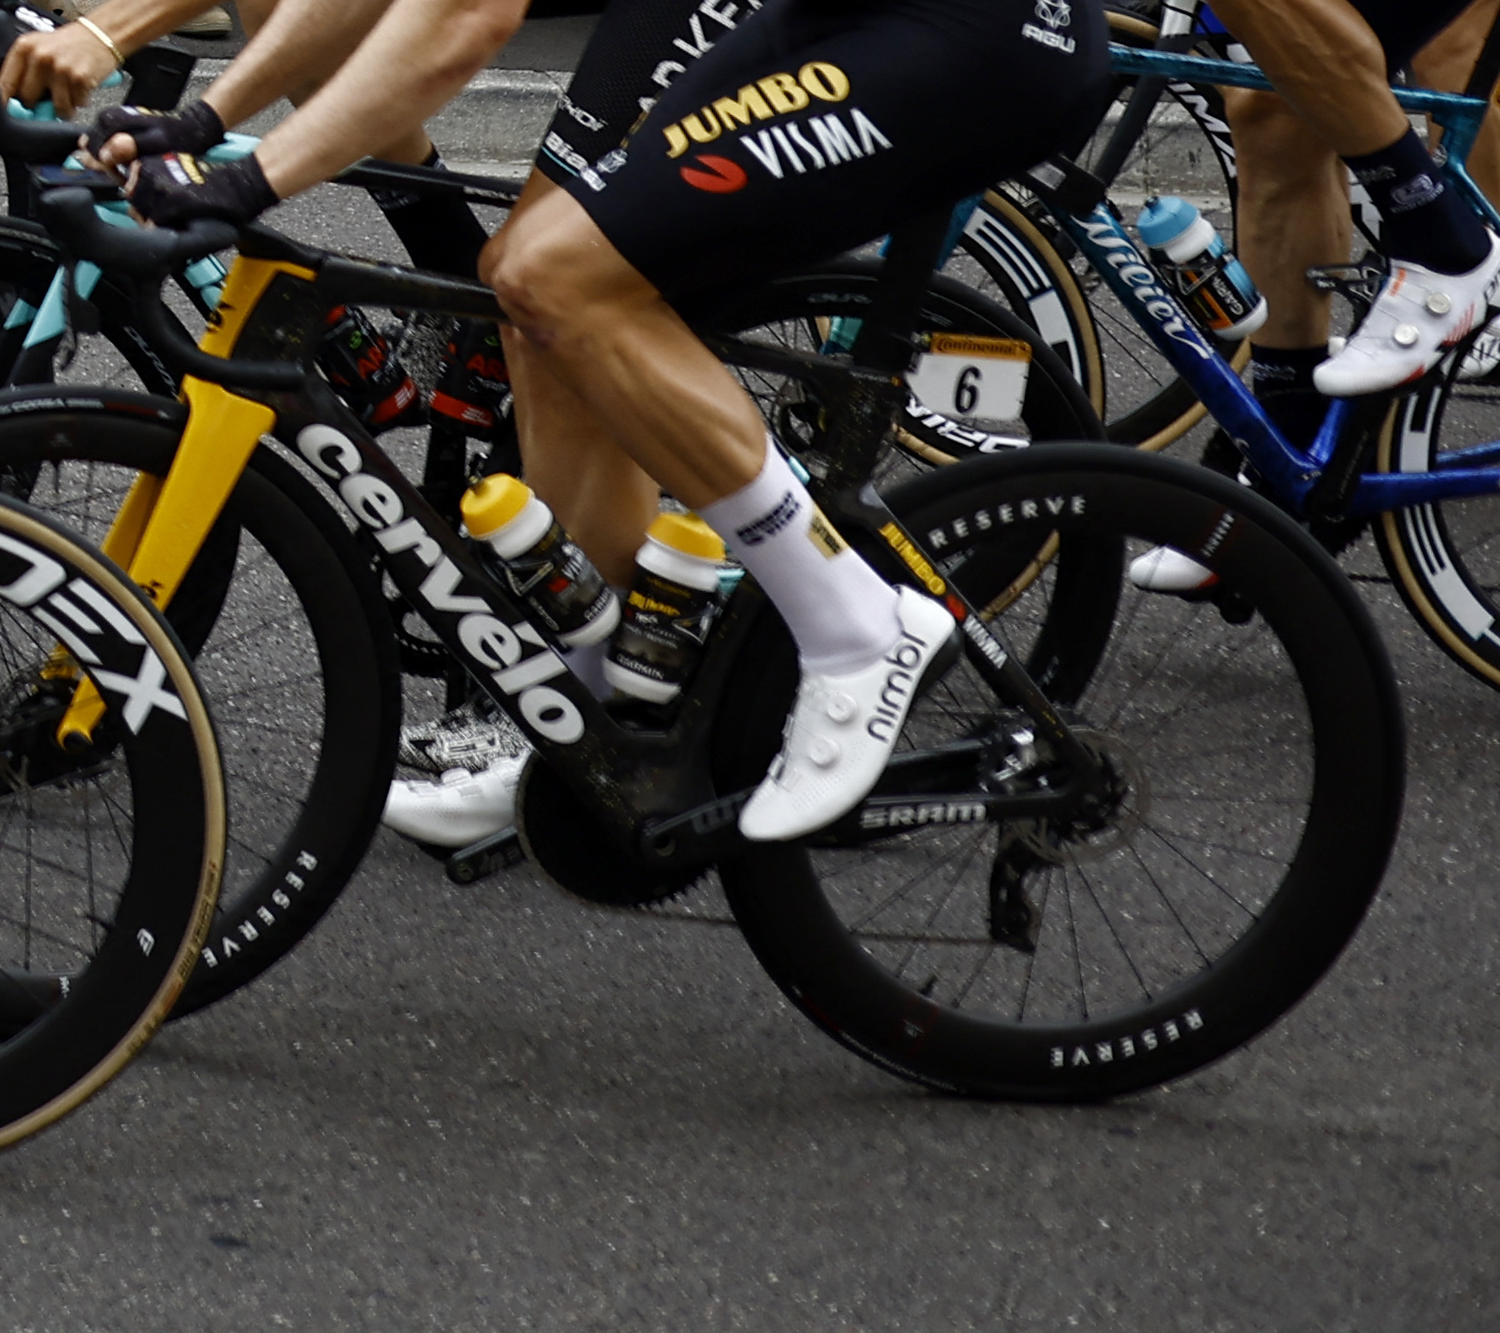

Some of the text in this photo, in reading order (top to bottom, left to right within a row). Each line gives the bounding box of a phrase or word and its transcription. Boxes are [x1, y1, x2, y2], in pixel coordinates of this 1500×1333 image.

[1021, 23, 1077, 55] AGU
[664, 60, 852, 160] JUMBO
[742, 109, 894, 179] VISMA
[954, 364, 982, 415] 6
[929, 496, 1088, 547] RESERVE
[300, 423, 587, 745] cervélo
[879, 522, 947, 598] JUMBO
[961, 615, 1010, 669] VISMA
[867, 629, 929, 743] nimbl
[200, 849, 319, 969] RESERVE
[1049, 1006, 1206, 1071] RESERVE
